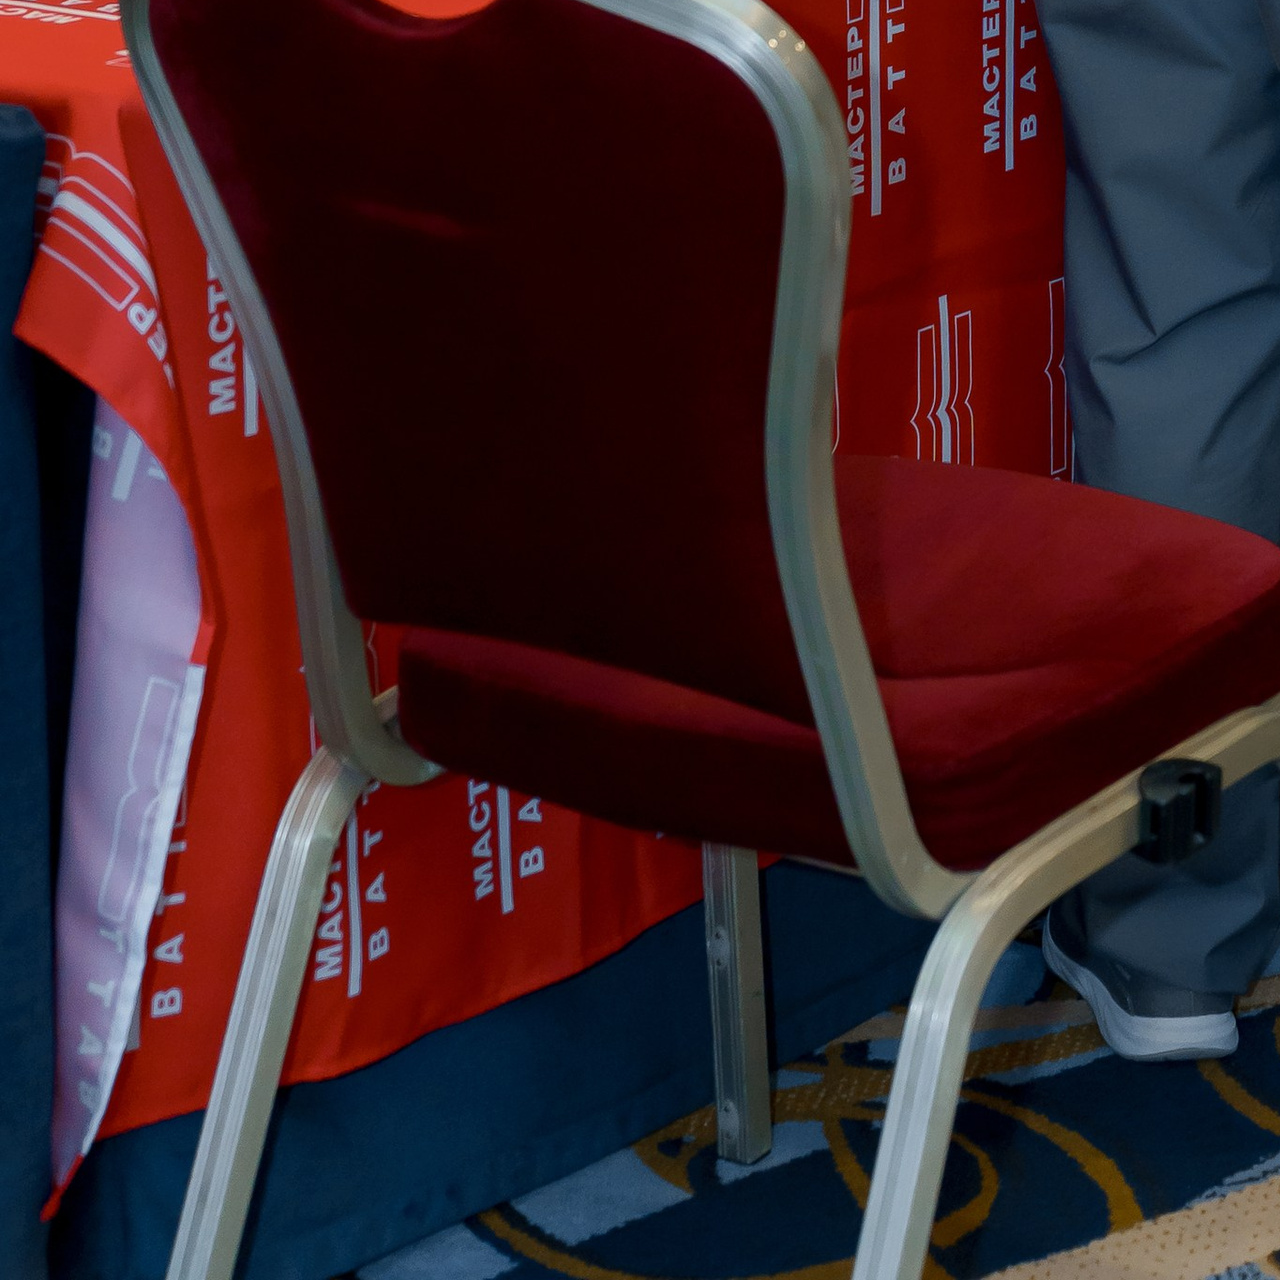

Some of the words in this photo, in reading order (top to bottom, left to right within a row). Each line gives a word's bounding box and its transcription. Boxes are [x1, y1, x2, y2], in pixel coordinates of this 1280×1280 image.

[847, 25, 865, 197] МАСТЕР
[887, 18, 907, 186] ВАТТ
[206, 254, 237, 416] МАСТ
[467, 778, 495, 901] МАСТ
[518, 796, 545, 879] ВА
[314, 859, 344, 983] МАС
